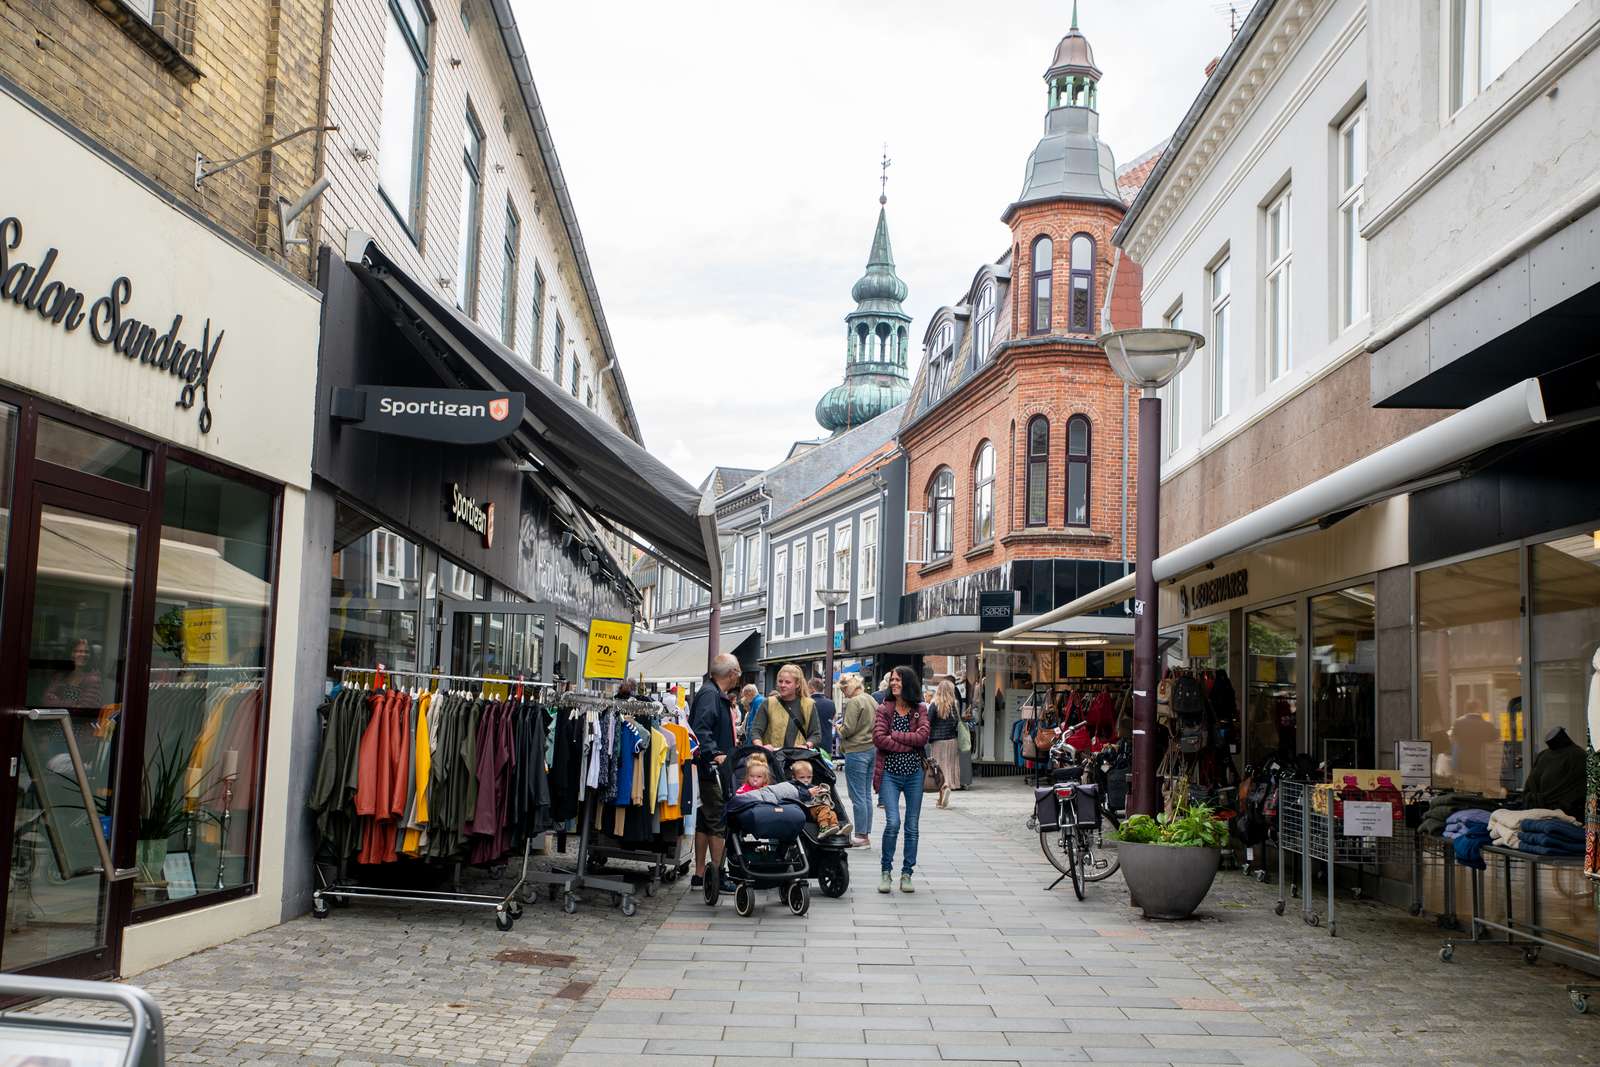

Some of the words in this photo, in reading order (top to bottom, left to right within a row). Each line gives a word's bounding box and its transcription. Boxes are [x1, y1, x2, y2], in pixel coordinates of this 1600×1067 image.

[89, 276, 202, 383] Sandra
[380, 398, 486, 417] Sportigan
[452, 482, 487, 536] Sportigan
[596, 645, 617, 656] 70,-
